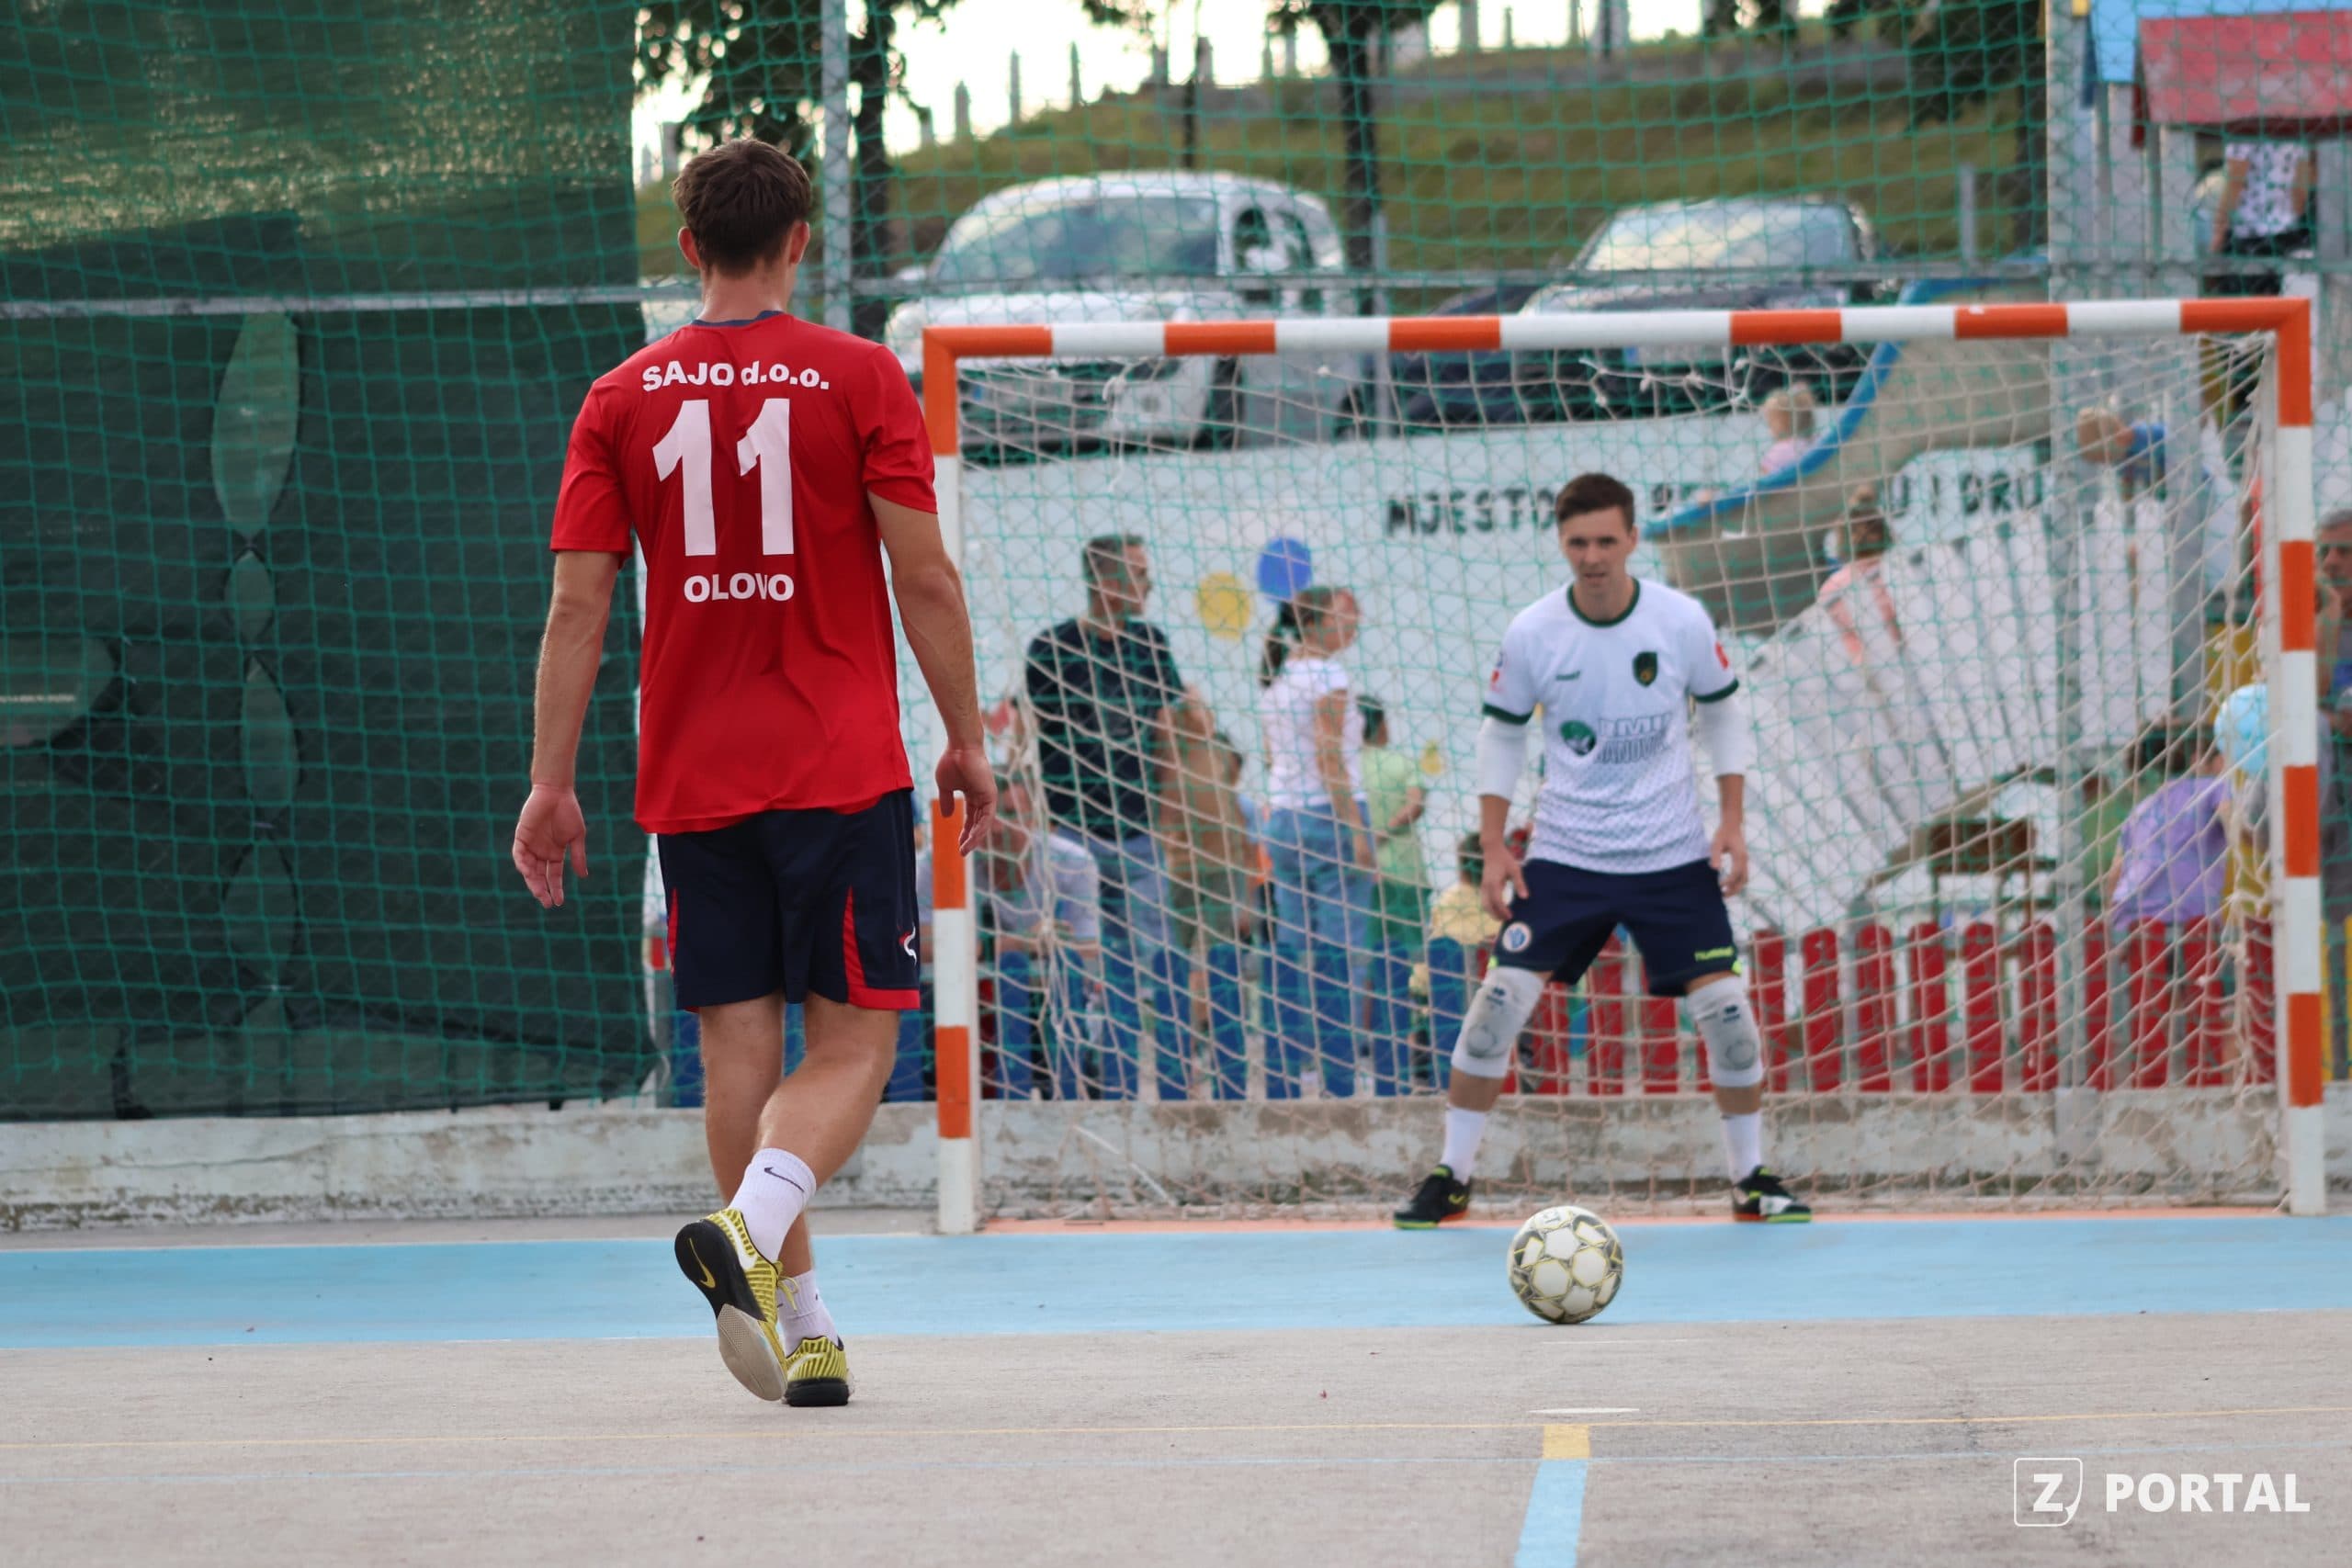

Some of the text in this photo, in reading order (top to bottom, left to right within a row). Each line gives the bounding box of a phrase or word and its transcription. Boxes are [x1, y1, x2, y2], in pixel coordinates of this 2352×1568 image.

[642, 360, 830, 392] SAJO d.o.o.
[652, 398, 795, 557] 11
[684, 572, 795, 603] OLOVO
